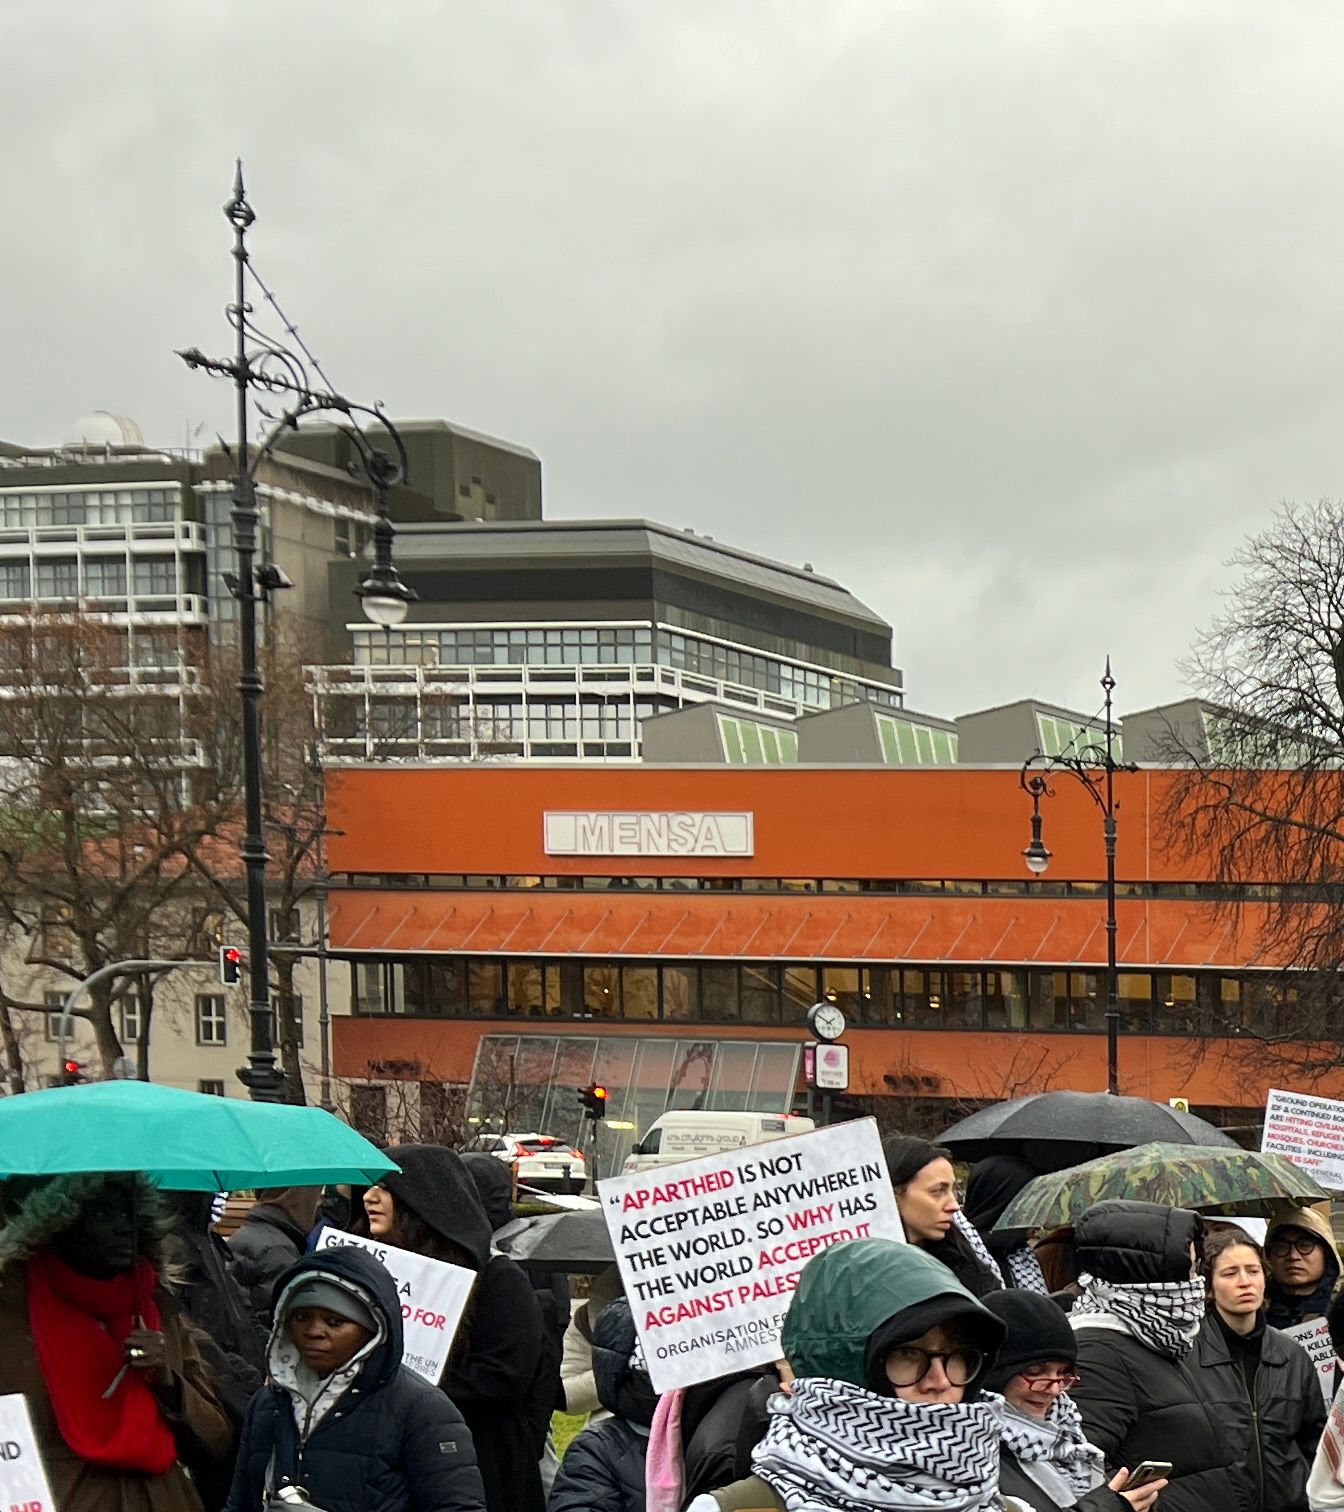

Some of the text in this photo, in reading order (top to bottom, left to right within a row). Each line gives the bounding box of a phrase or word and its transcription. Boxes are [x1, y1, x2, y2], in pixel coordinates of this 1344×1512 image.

[575, 813, 727, 853] MENSA
[1270, 1114, 1284, 1122] ARE
[1285, 1116, 1313, 1127] HITTING
[1291, 1108, 1332, 1120] CONTINUED
[1306, 1139, 1344, 1152] CHURCHES
[1311, 1129, 1341, 1141] REFUGEE
[1266, 1141, 1301, 1154] FACILITIES
[609, 1153, 803, 1212] “APARTHEID IS NOT
[619, 1162, 882, 1244] ACCEPTABLE ANYWHERE IN
[625, 1193, 877, 1273] THE WORLD. SO WHY HAS
[633, 1276, 674, 1301] THE
[675, 1255, 753, 1292] WORLD
[850, 1223, 871, 1239] IT
[400, 1282, 411, 1297] A
[414, 1309, 446, 1331] FOR
[644, 1290, 735, 1331] AGAINST
[656, 1317, 769, 1360] ORGANISATION
[405, 1352, 423, 1365] THE
[425, 1359, 439, 1369] UN
